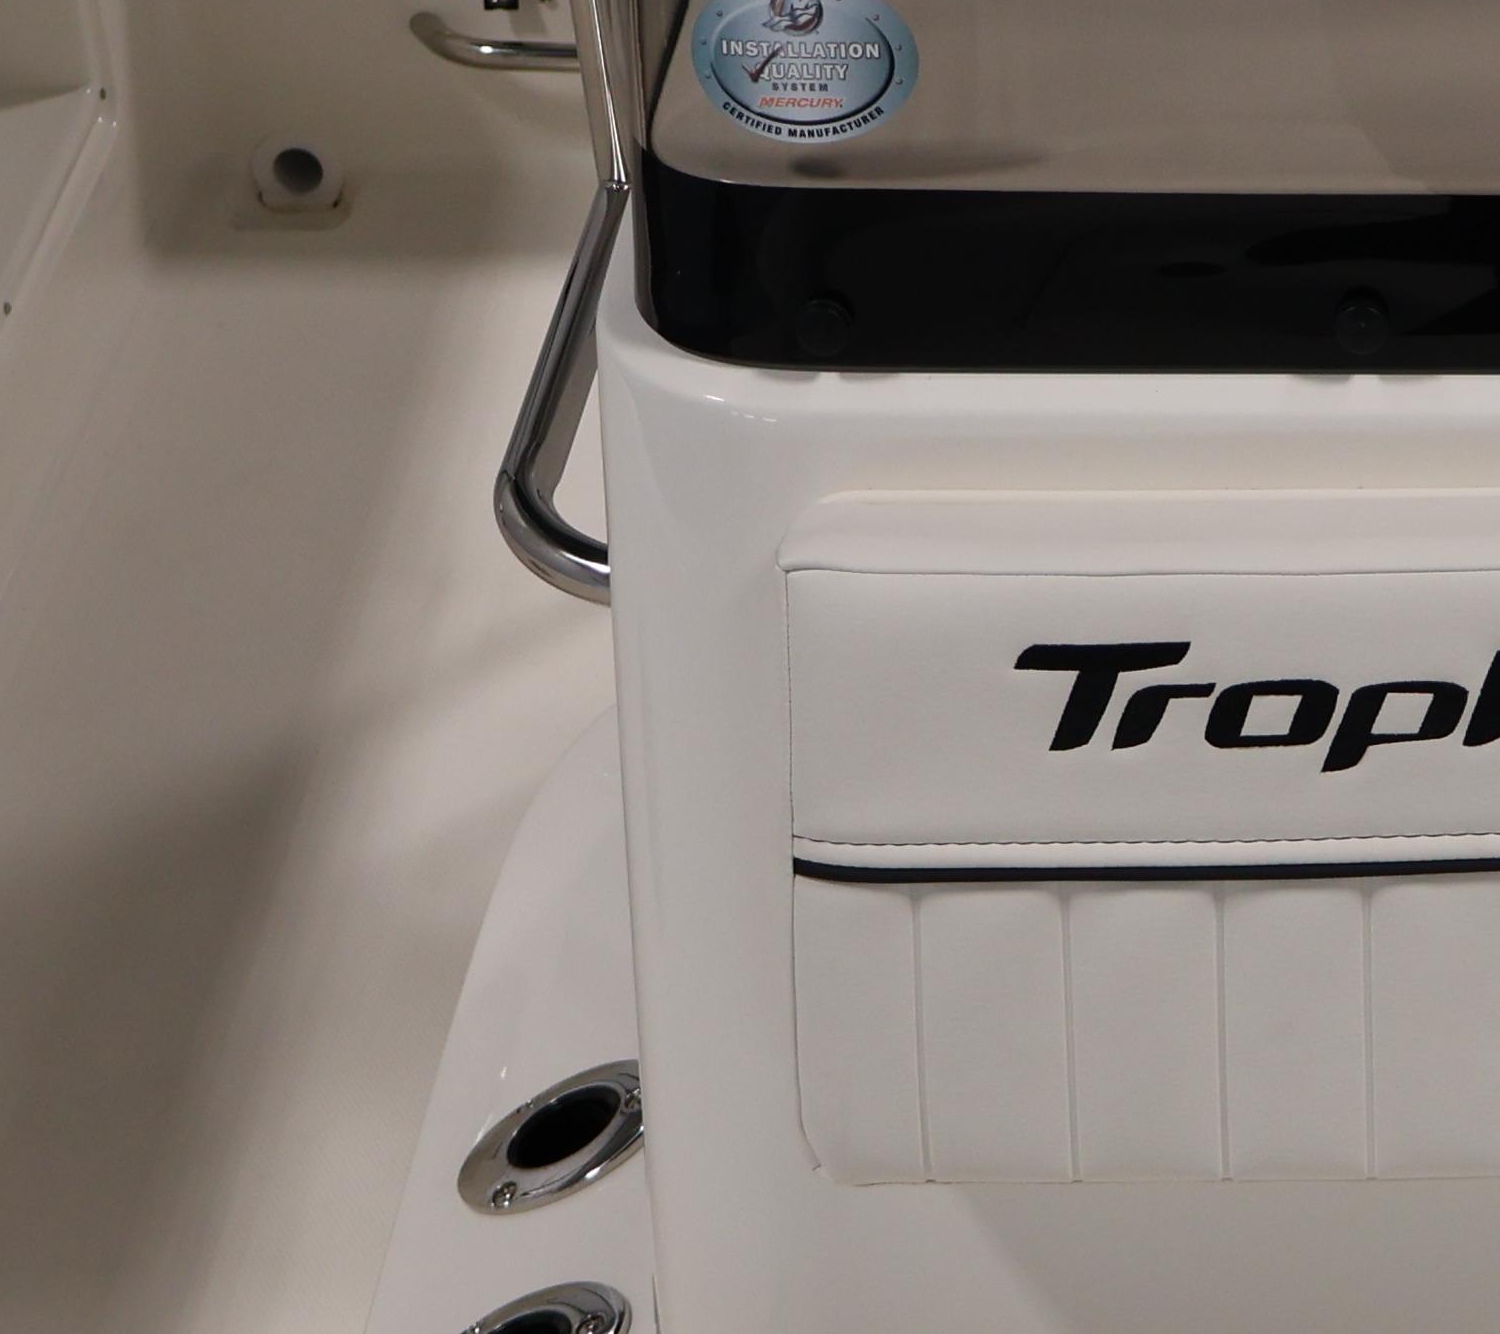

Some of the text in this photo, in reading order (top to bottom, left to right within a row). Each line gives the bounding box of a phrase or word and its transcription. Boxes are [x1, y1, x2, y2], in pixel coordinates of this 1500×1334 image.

[721, 39, 881, 60] INSTALLATION
[756, 62, 849, 81] QUALITY
[771, 82, 829, 92] SYSTEM
[759, 97, 842, 108] MERCURY
[722, 101, 885, 139] CERTIFIED MANUFACTURER
